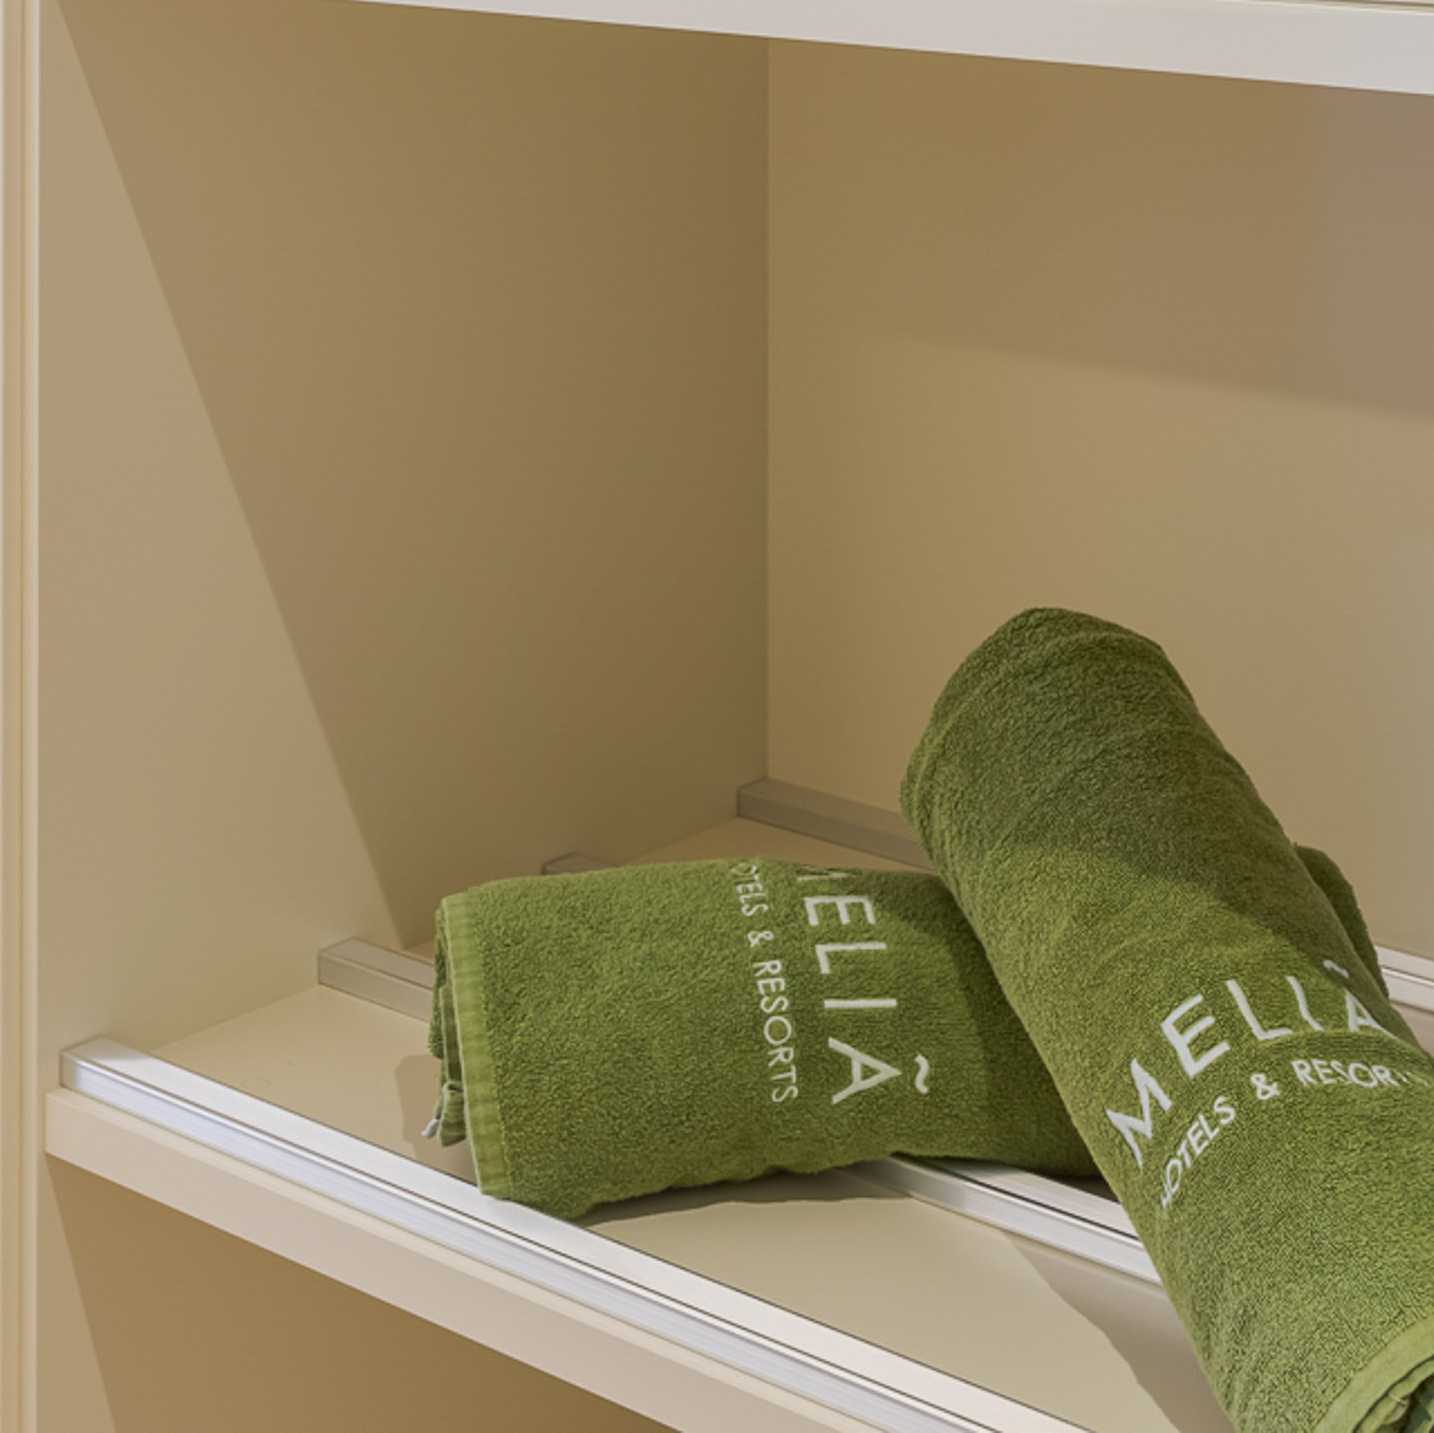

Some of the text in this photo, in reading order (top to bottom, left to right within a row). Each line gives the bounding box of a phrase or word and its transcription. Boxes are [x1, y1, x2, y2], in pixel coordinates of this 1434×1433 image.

[731, 863, 800, 1104] OTELS & RESORTS
[1250, 1073, 1280, 1100] &
